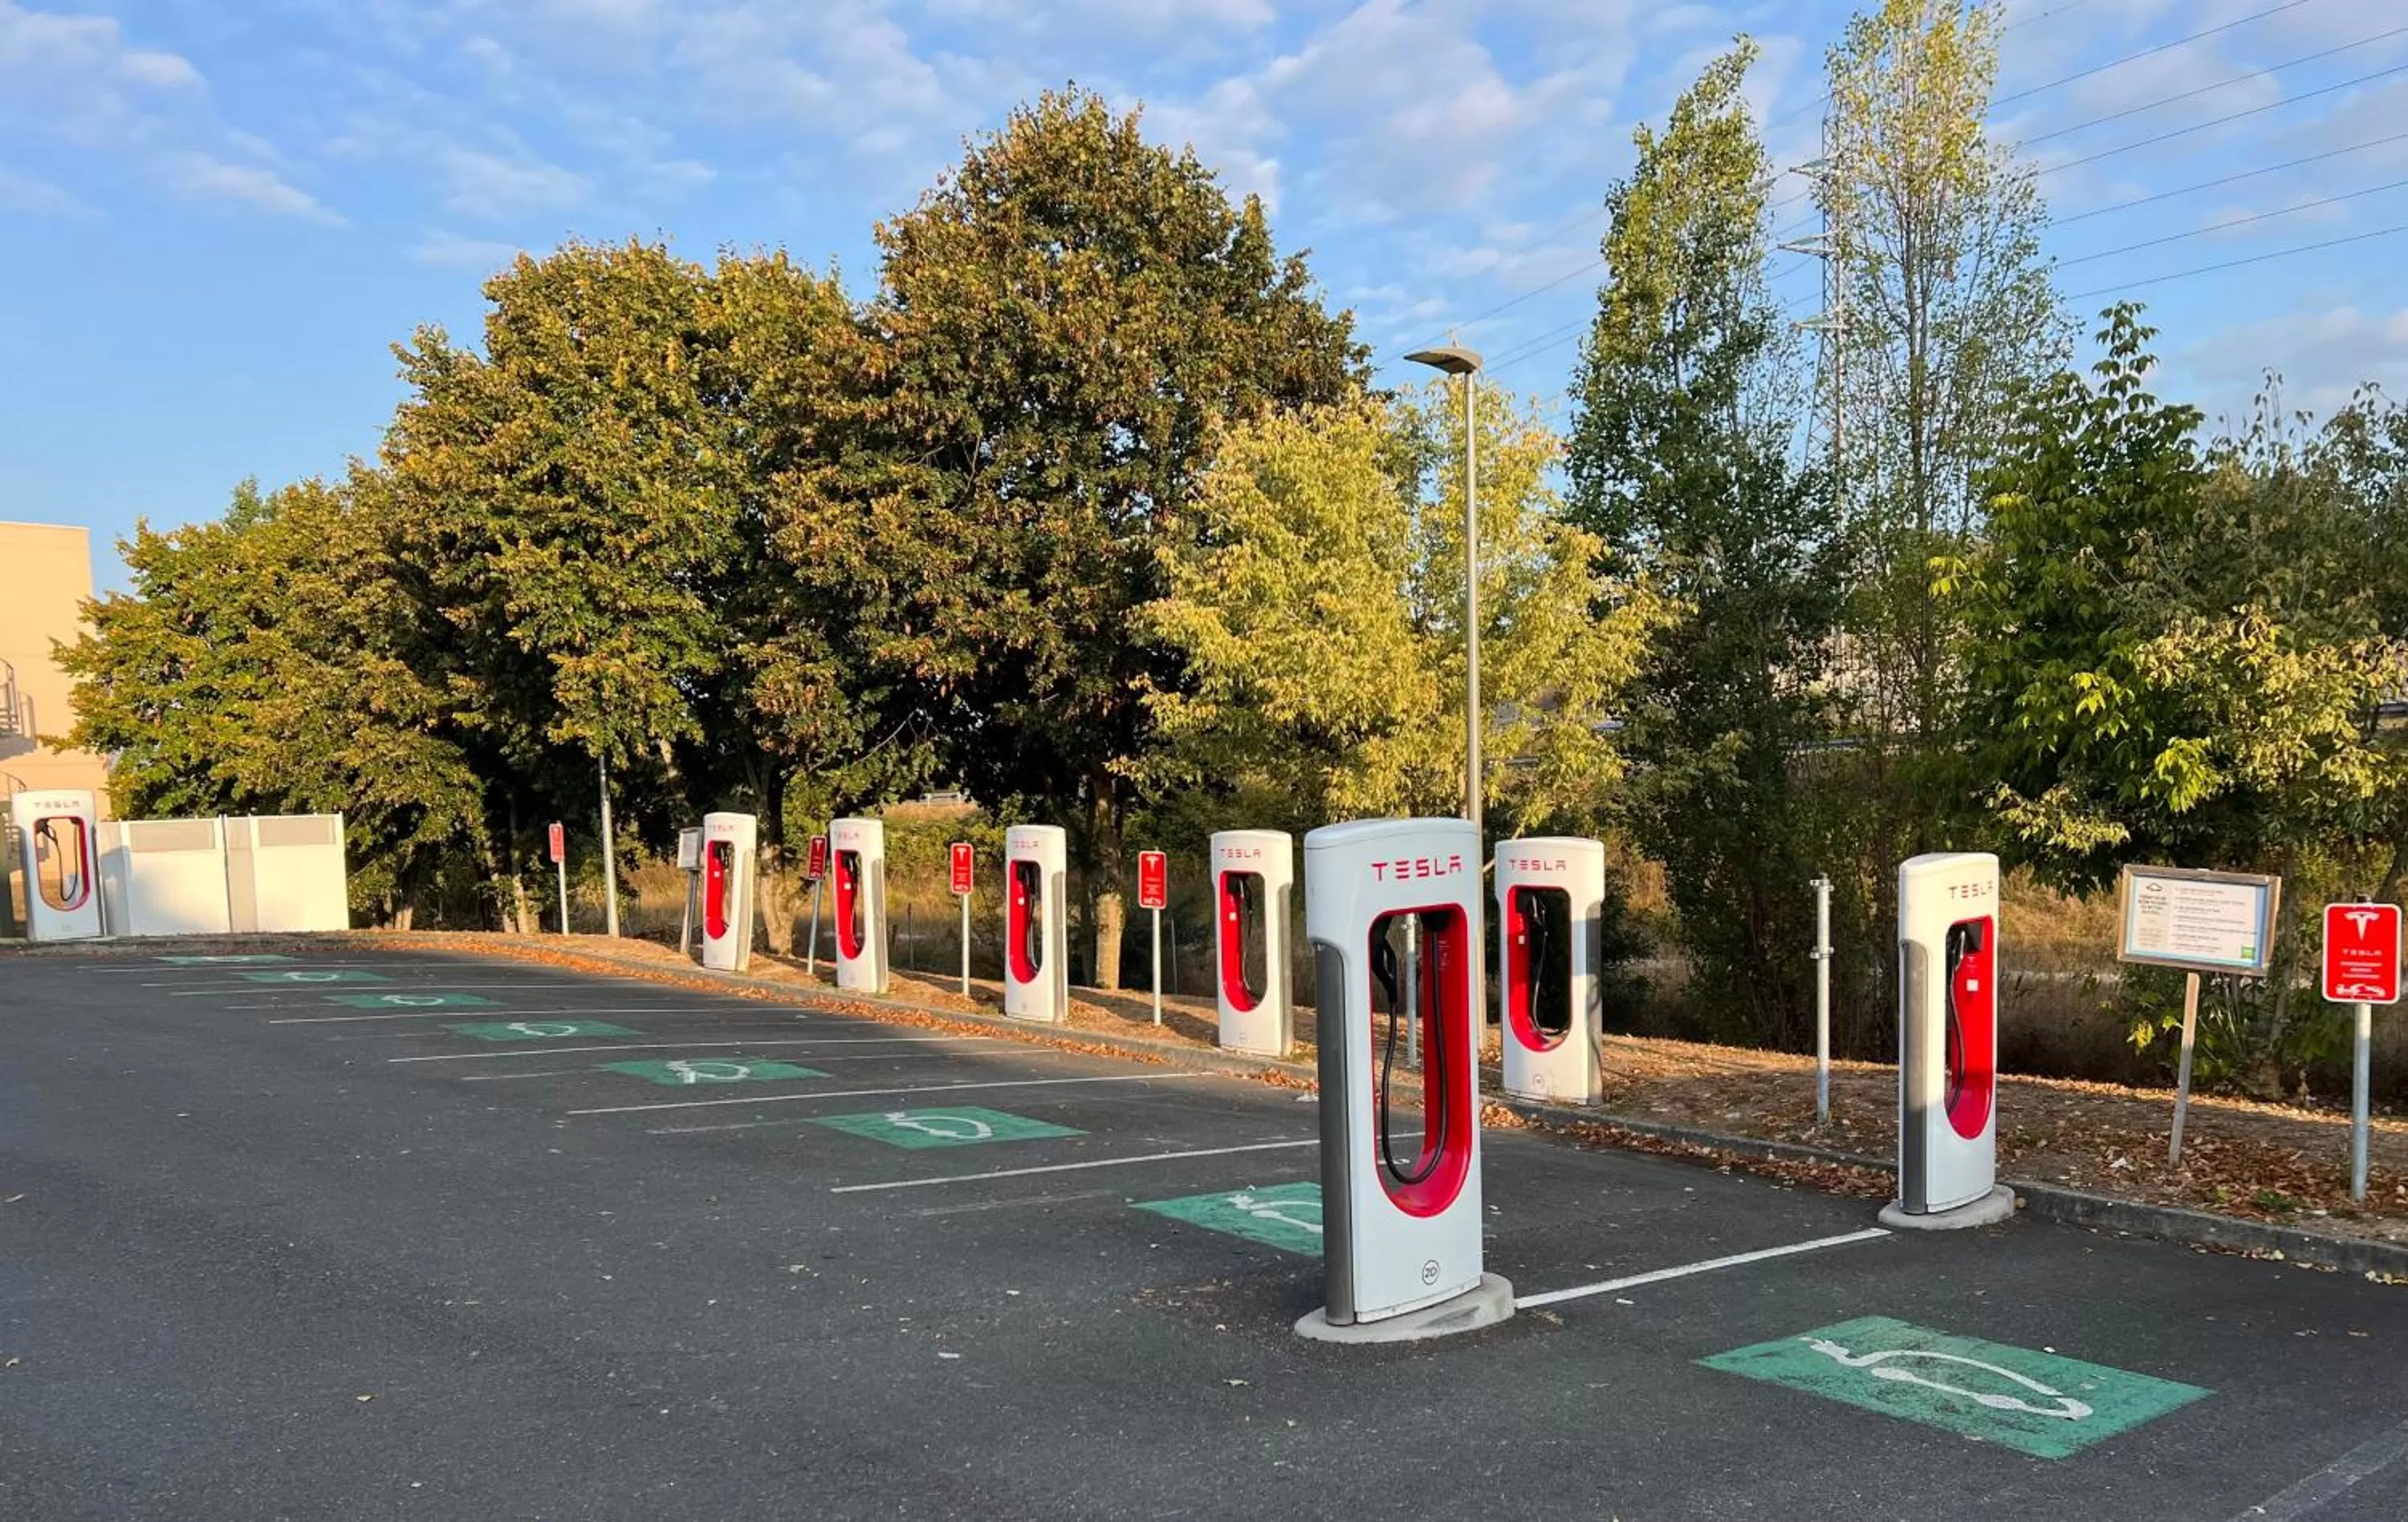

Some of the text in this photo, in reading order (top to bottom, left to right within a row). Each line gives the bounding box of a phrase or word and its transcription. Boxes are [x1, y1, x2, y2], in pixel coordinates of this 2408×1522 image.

[1219, 848, 1262, 859] TESLA
[1370, 854, 1462, 882] TESLA
[1508, 859, 1567, 872] TESLA
[1947, 880, 1994, 900] TESLA
